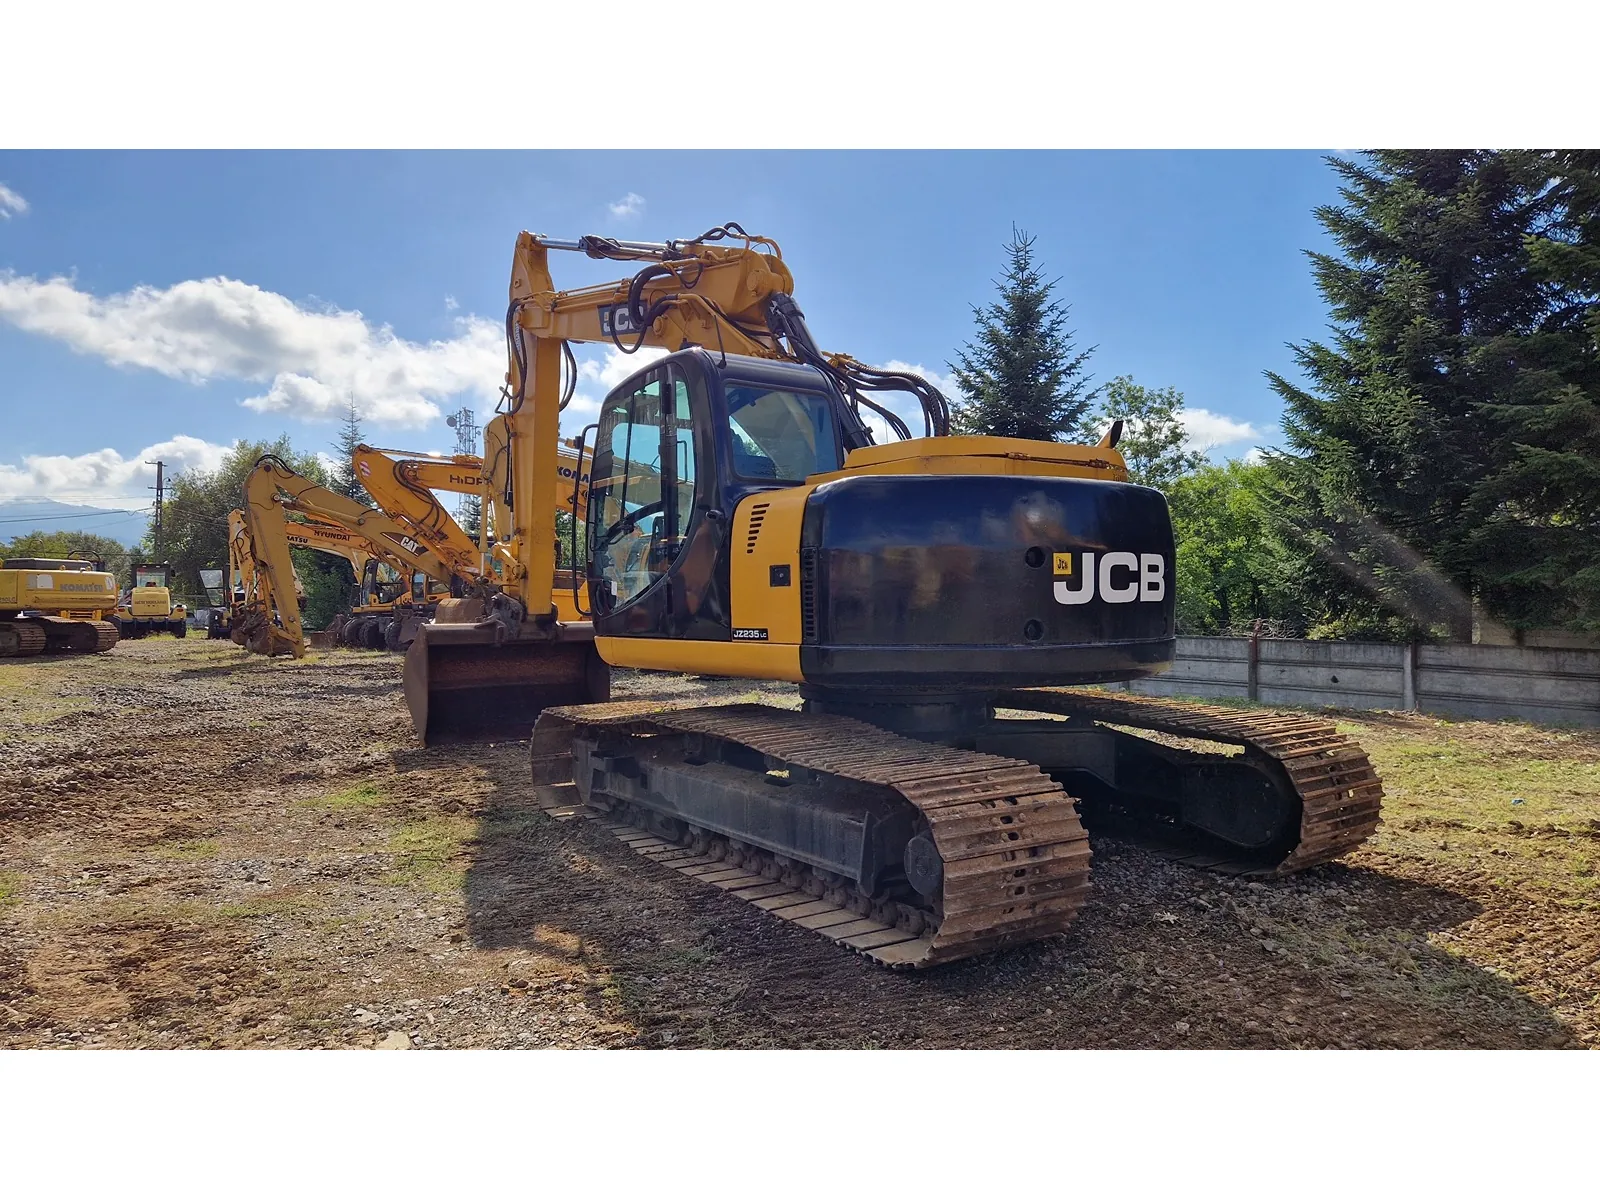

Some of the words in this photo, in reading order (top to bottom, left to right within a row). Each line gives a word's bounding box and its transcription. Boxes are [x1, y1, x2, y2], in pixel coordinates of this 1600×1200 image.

[314, 530, 350, 541] HYUNDAI
[400, 536, 419, 552] CAT
[1053, 552, 1165, 605] JCB
[60, 583, 104, 593] KOMATSU
[733, 629, 760, 639] JZ235
